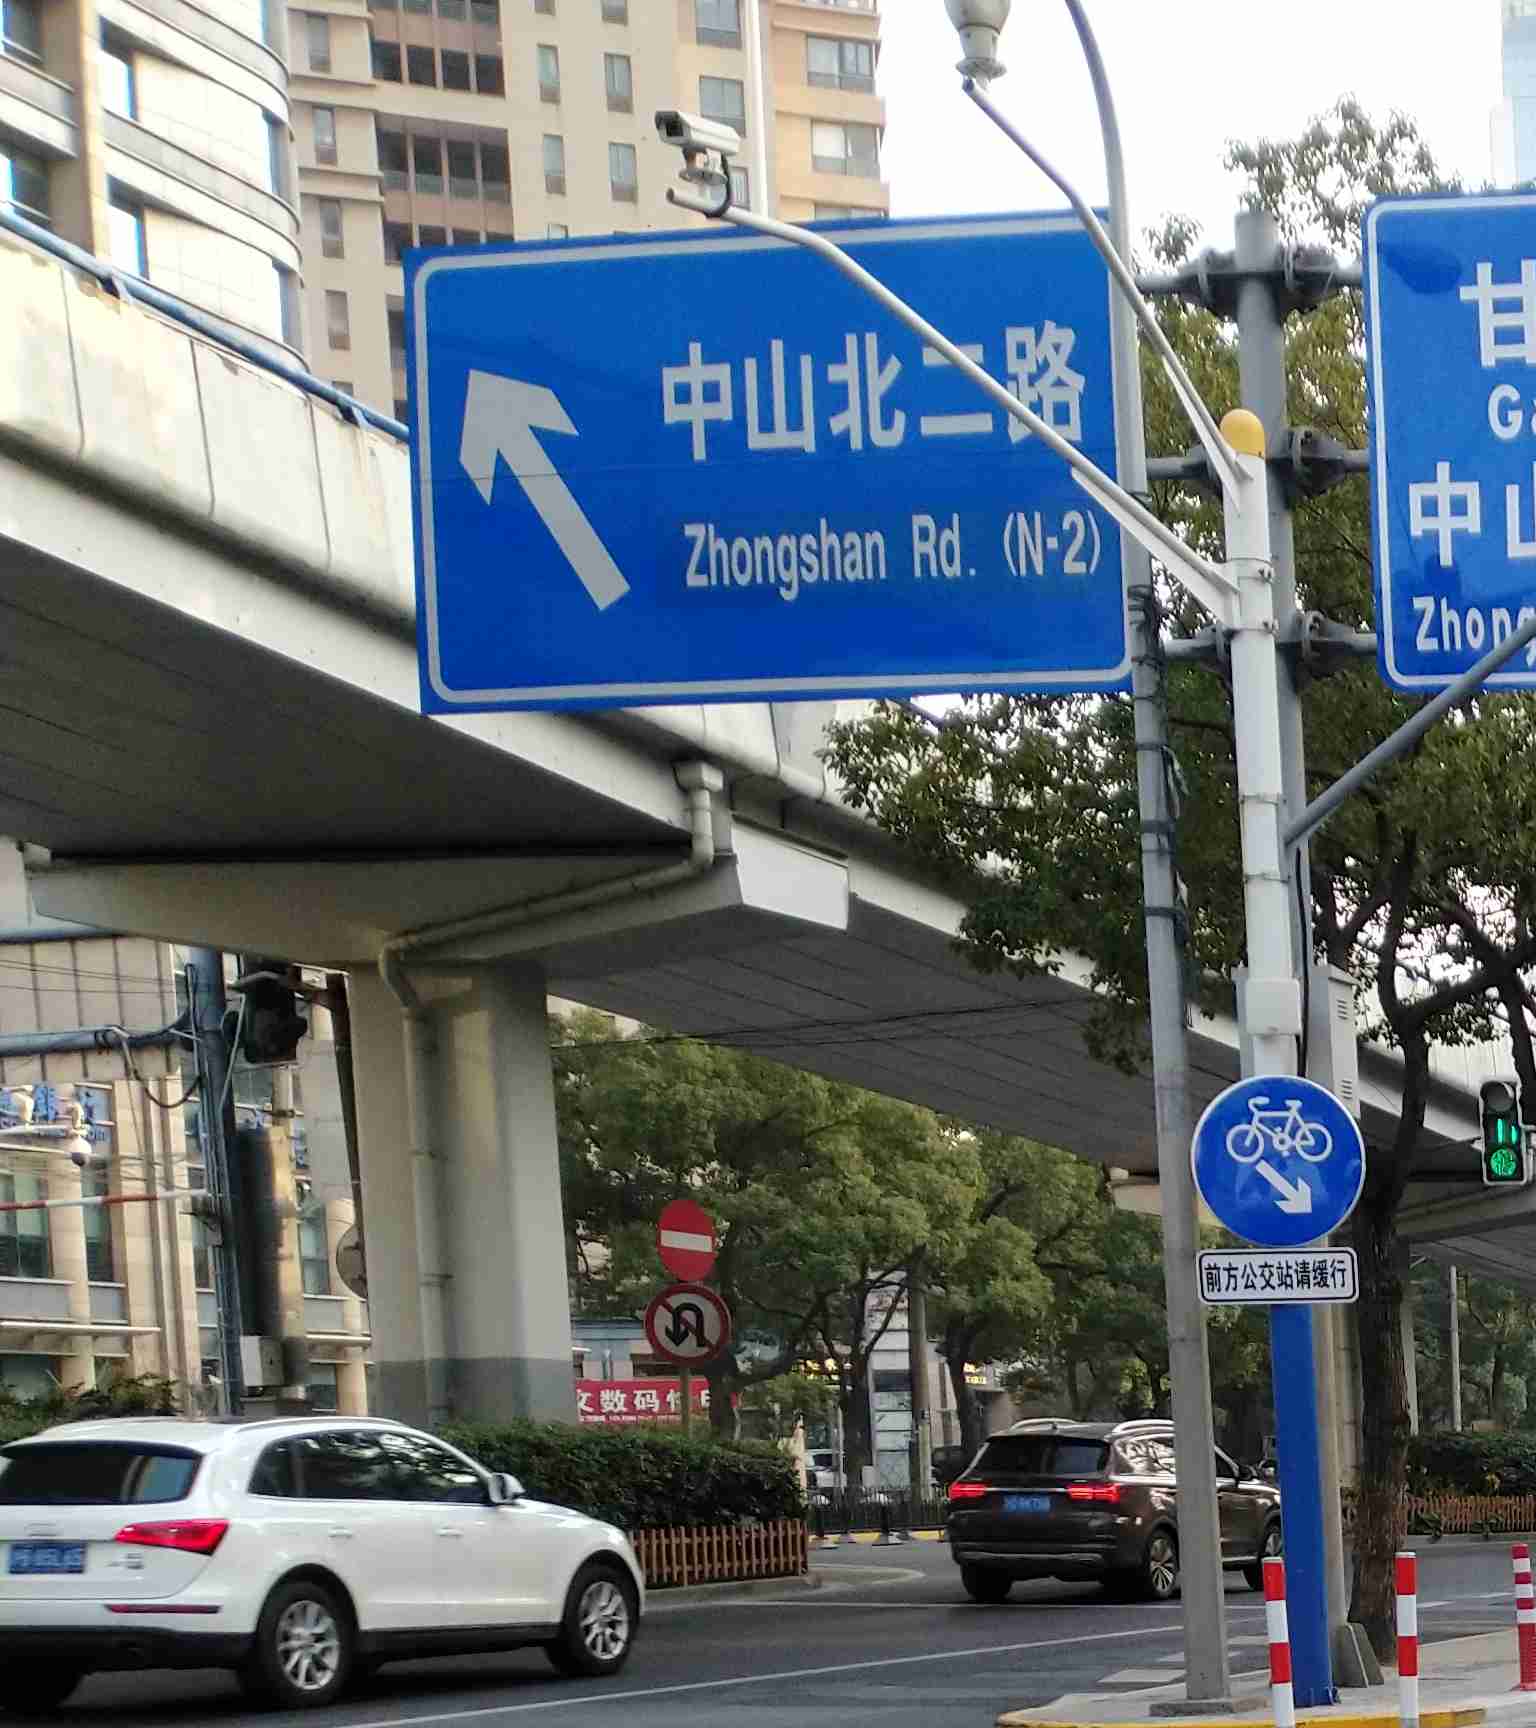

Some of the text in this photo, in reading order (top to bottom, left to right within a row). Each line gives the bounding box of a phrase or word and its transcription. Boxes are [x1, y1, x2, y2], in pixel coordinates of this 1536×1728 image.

[662, 320, 1086, 463] 中山北二路
[684, 510, 1102, 601] Zhongshan Rd. (N-2)
[1203, 1258, 1347, 1293] 前方公交站请缓行
